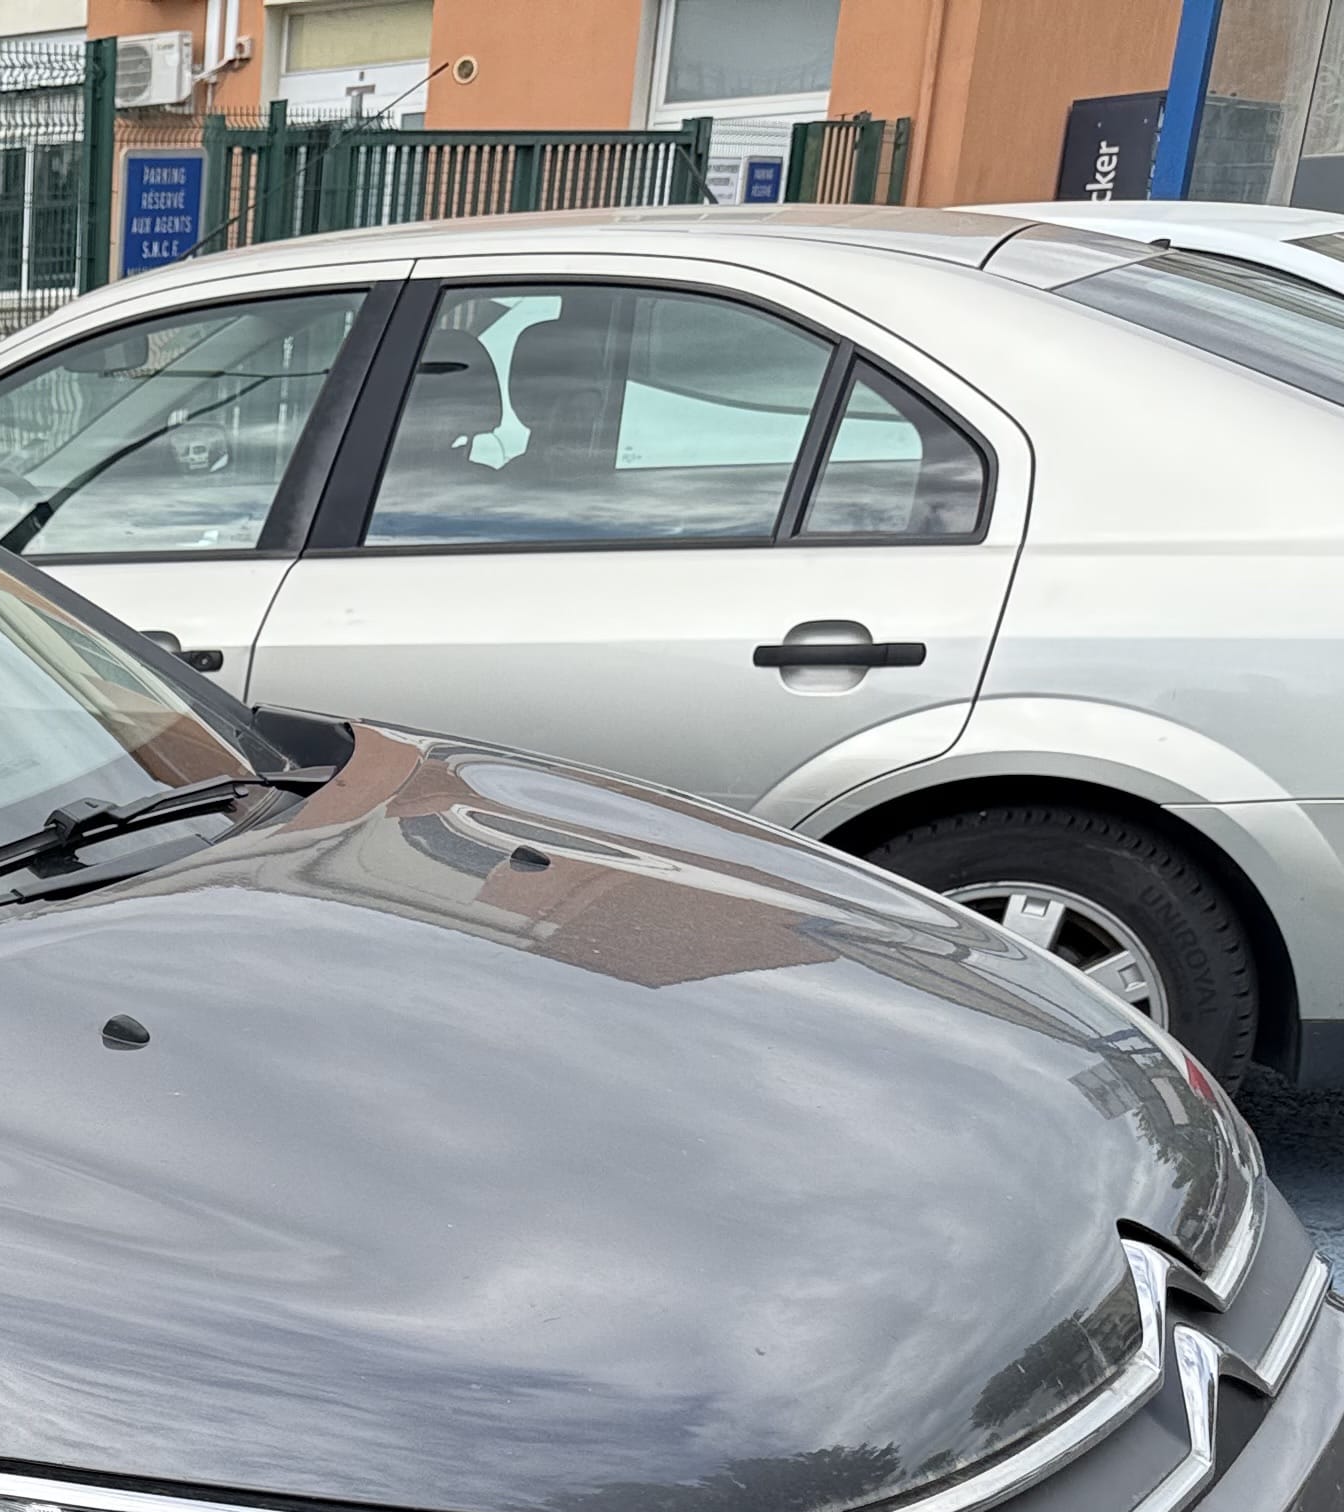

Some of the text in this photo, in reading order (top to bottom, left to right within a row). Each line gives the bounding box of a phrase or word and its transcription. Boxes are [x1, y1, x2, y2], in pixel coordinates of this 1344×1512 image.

[143, 165, 187, 185] PARKING
[141, 188, 185, 210] RÉSERVÉ
[131, 215, 193, 235] AUX AGENTS
[1138, 884, 1218, 1017] UNIROYAL
